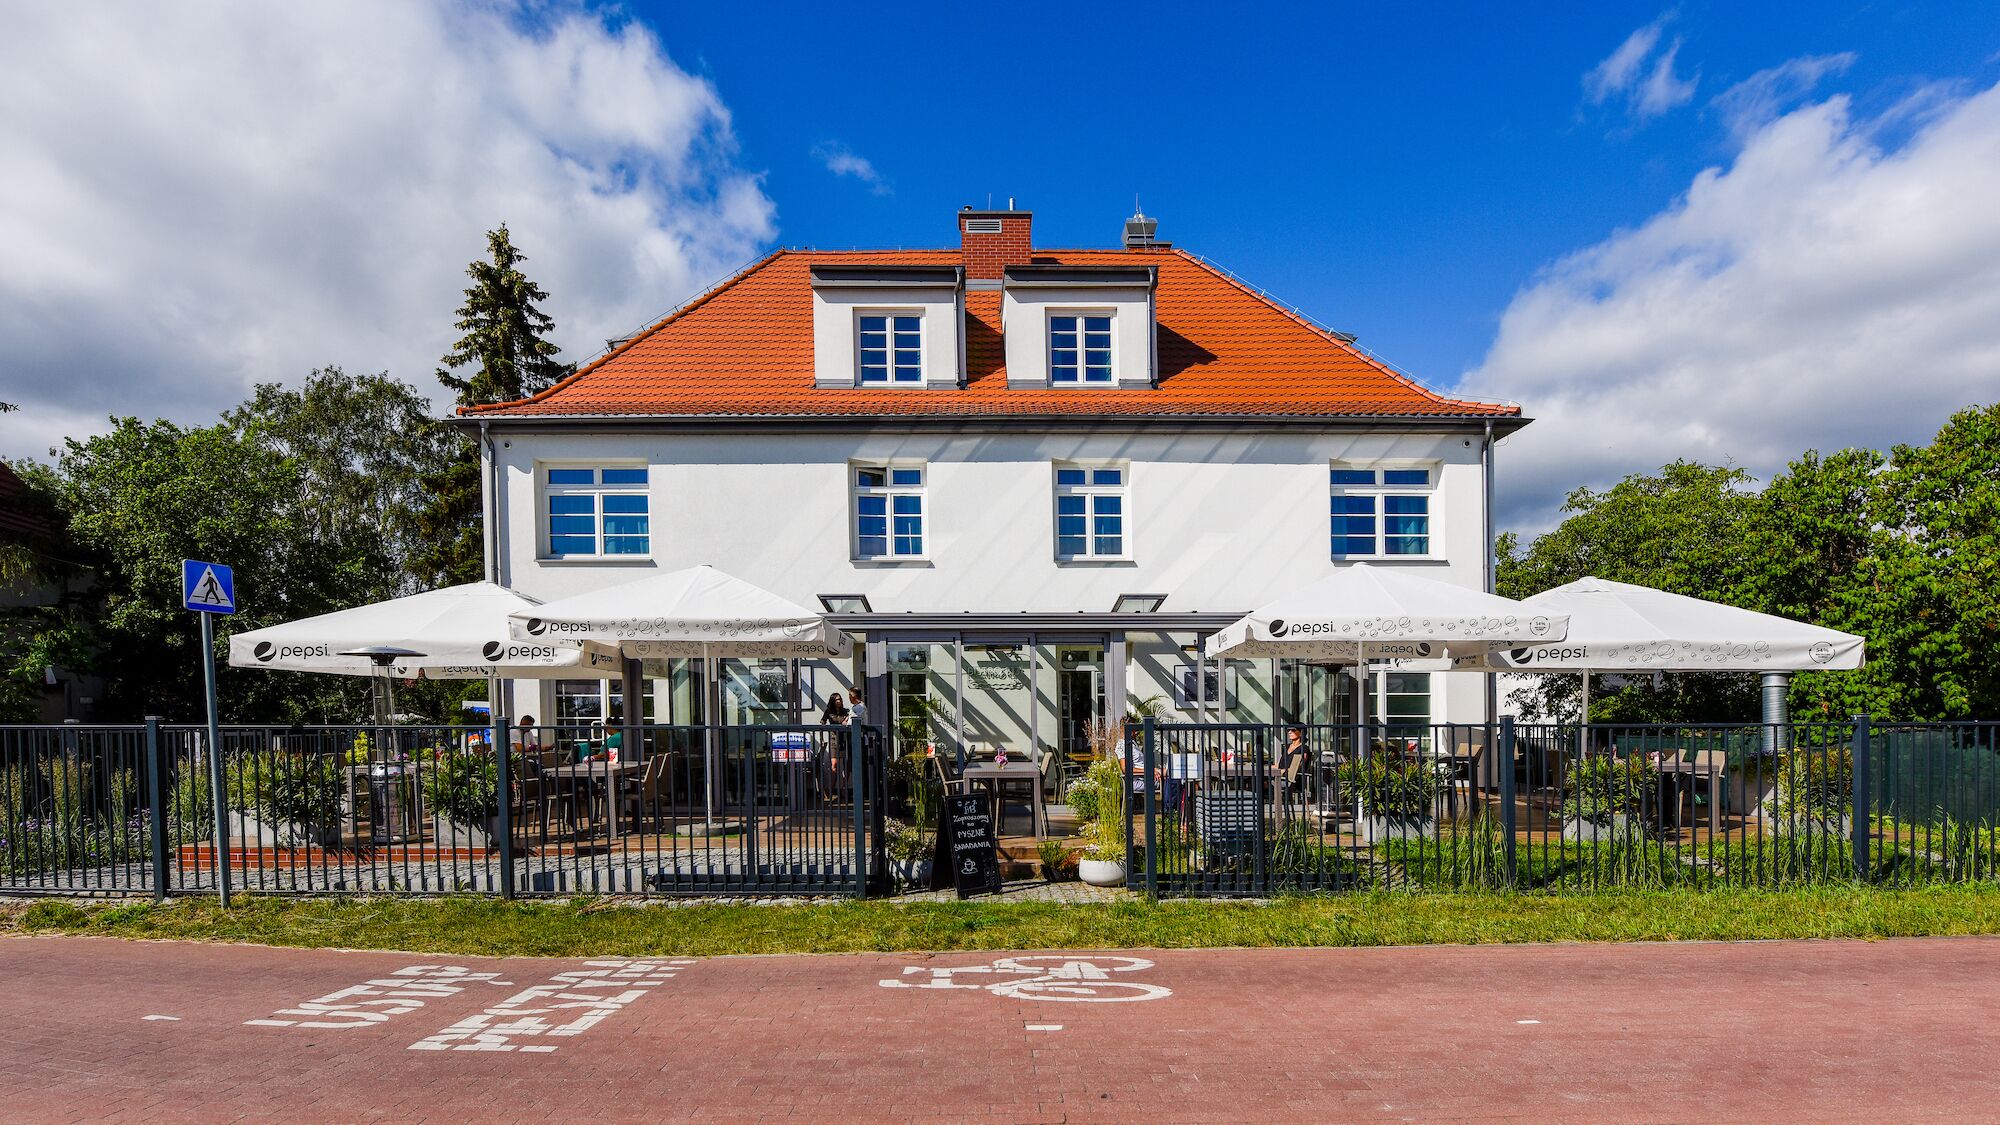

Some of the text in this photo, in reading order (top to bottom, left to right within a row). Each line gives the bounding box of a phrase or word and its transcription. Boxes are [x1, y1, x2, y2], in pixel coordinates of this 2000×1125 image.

[550, 621, 591, 634] pepsi
[1292, 621, 1333, 635] pepsi
[280, 643, 328, 660] pepsi
[508, 647, 555, 660] pepsi
[1537, 645, 1586, 662] pepsi
[957, 828, 986, 838] PYSZNE
[407, 959, 698, 1052] PIESZYM
